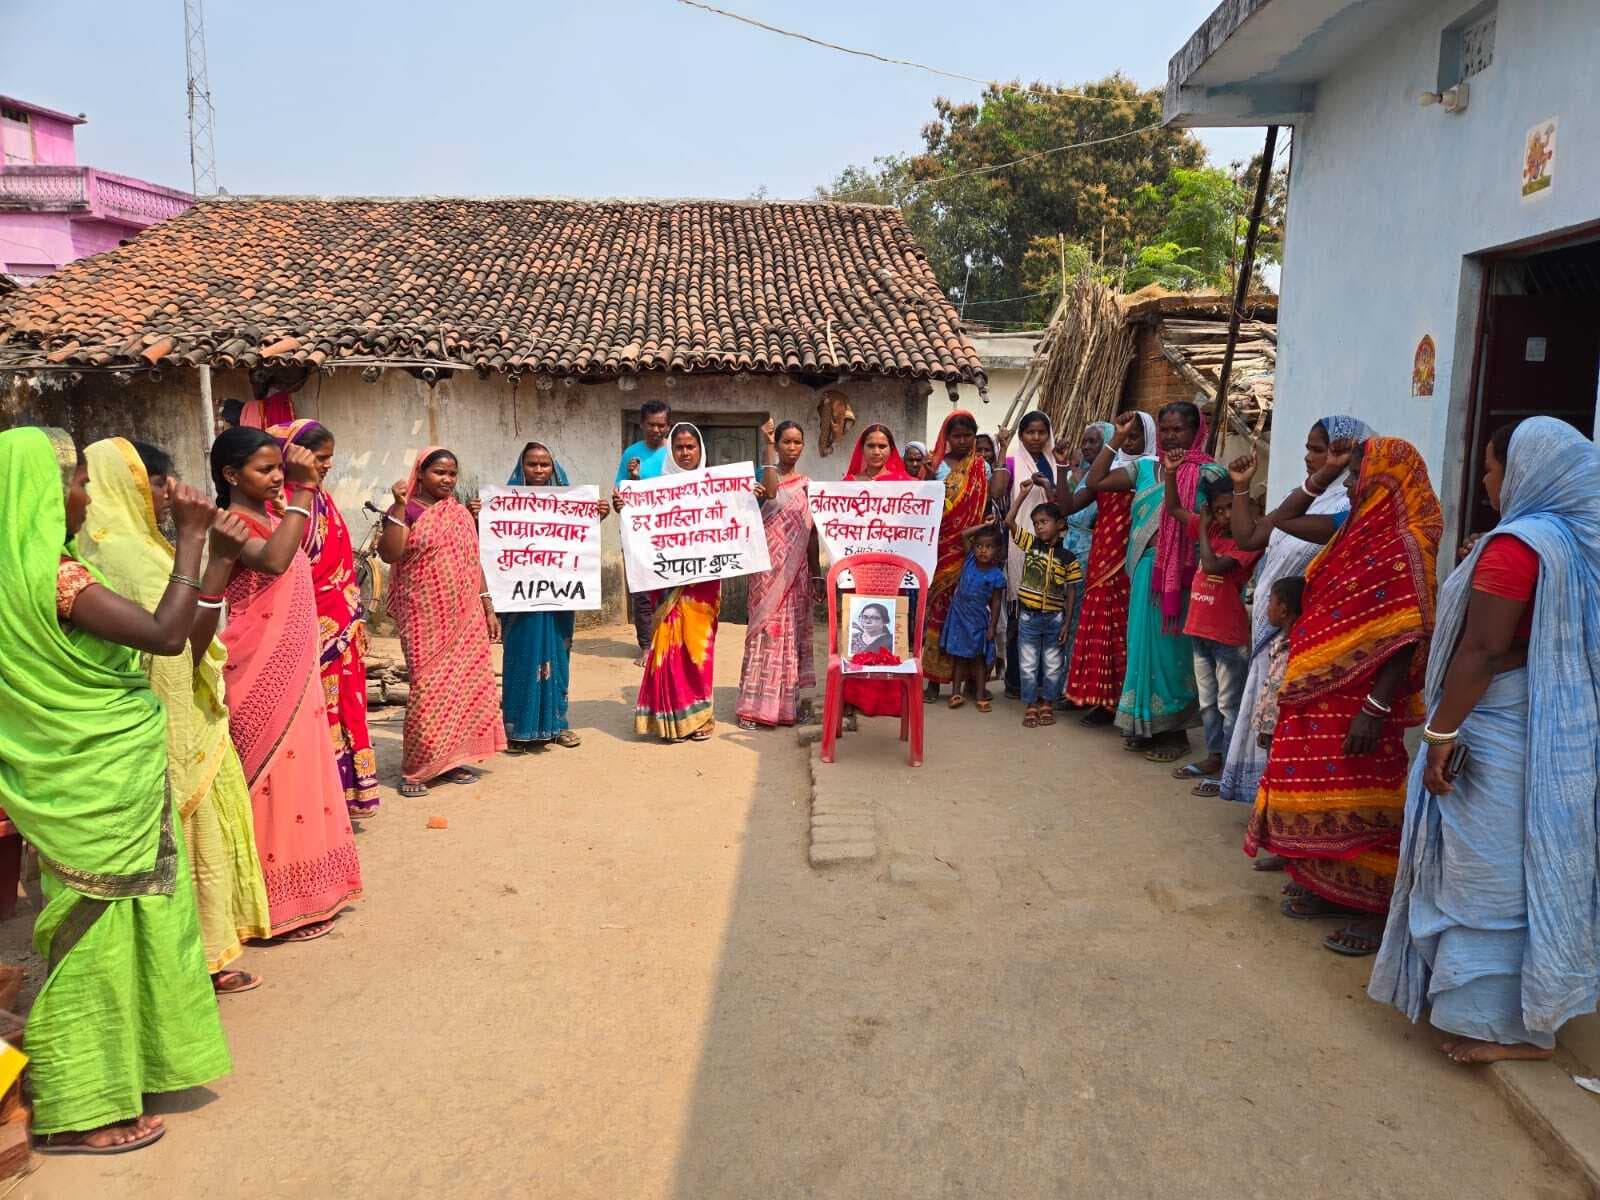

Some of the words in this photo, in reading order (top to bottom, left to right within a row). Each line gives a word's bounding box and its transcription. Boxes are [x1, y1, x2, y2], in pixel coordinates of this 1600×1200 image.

[882, 491, 935, 516] महिला
[631, 513, 651, 532] हर
[654, 505, 704, 529] महिला
[822, 518, 864, 541] दिवस
[489, 520, 590, 543] साम्राज्यवाद
[511, 580, 586, 600] AIPWA
